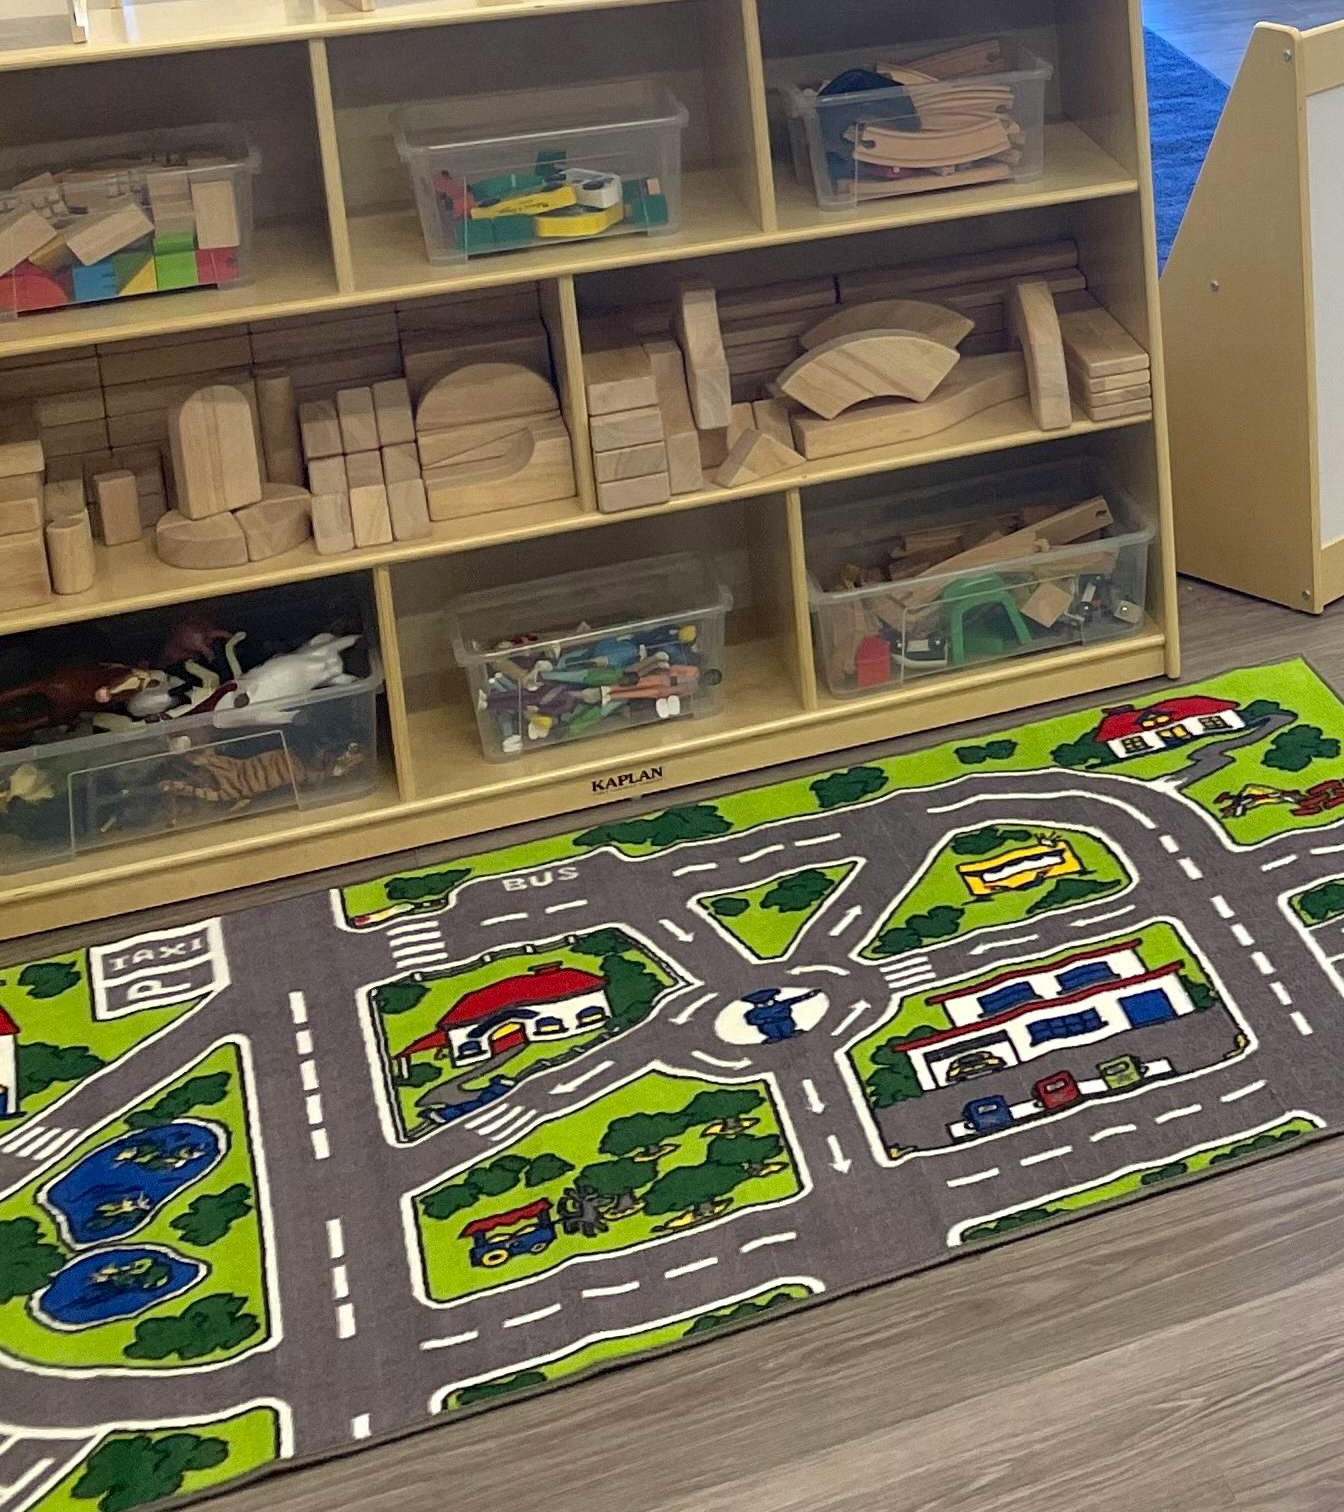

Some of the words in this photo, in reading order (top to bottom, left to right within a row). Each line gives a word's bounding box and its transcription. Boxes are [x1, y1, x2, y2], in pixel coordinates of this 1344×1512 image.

[592, 766, 663, 792] KAPLAN
[502, 866, 580, 892] BUS
[109, 938, 203, 972] TAXI
